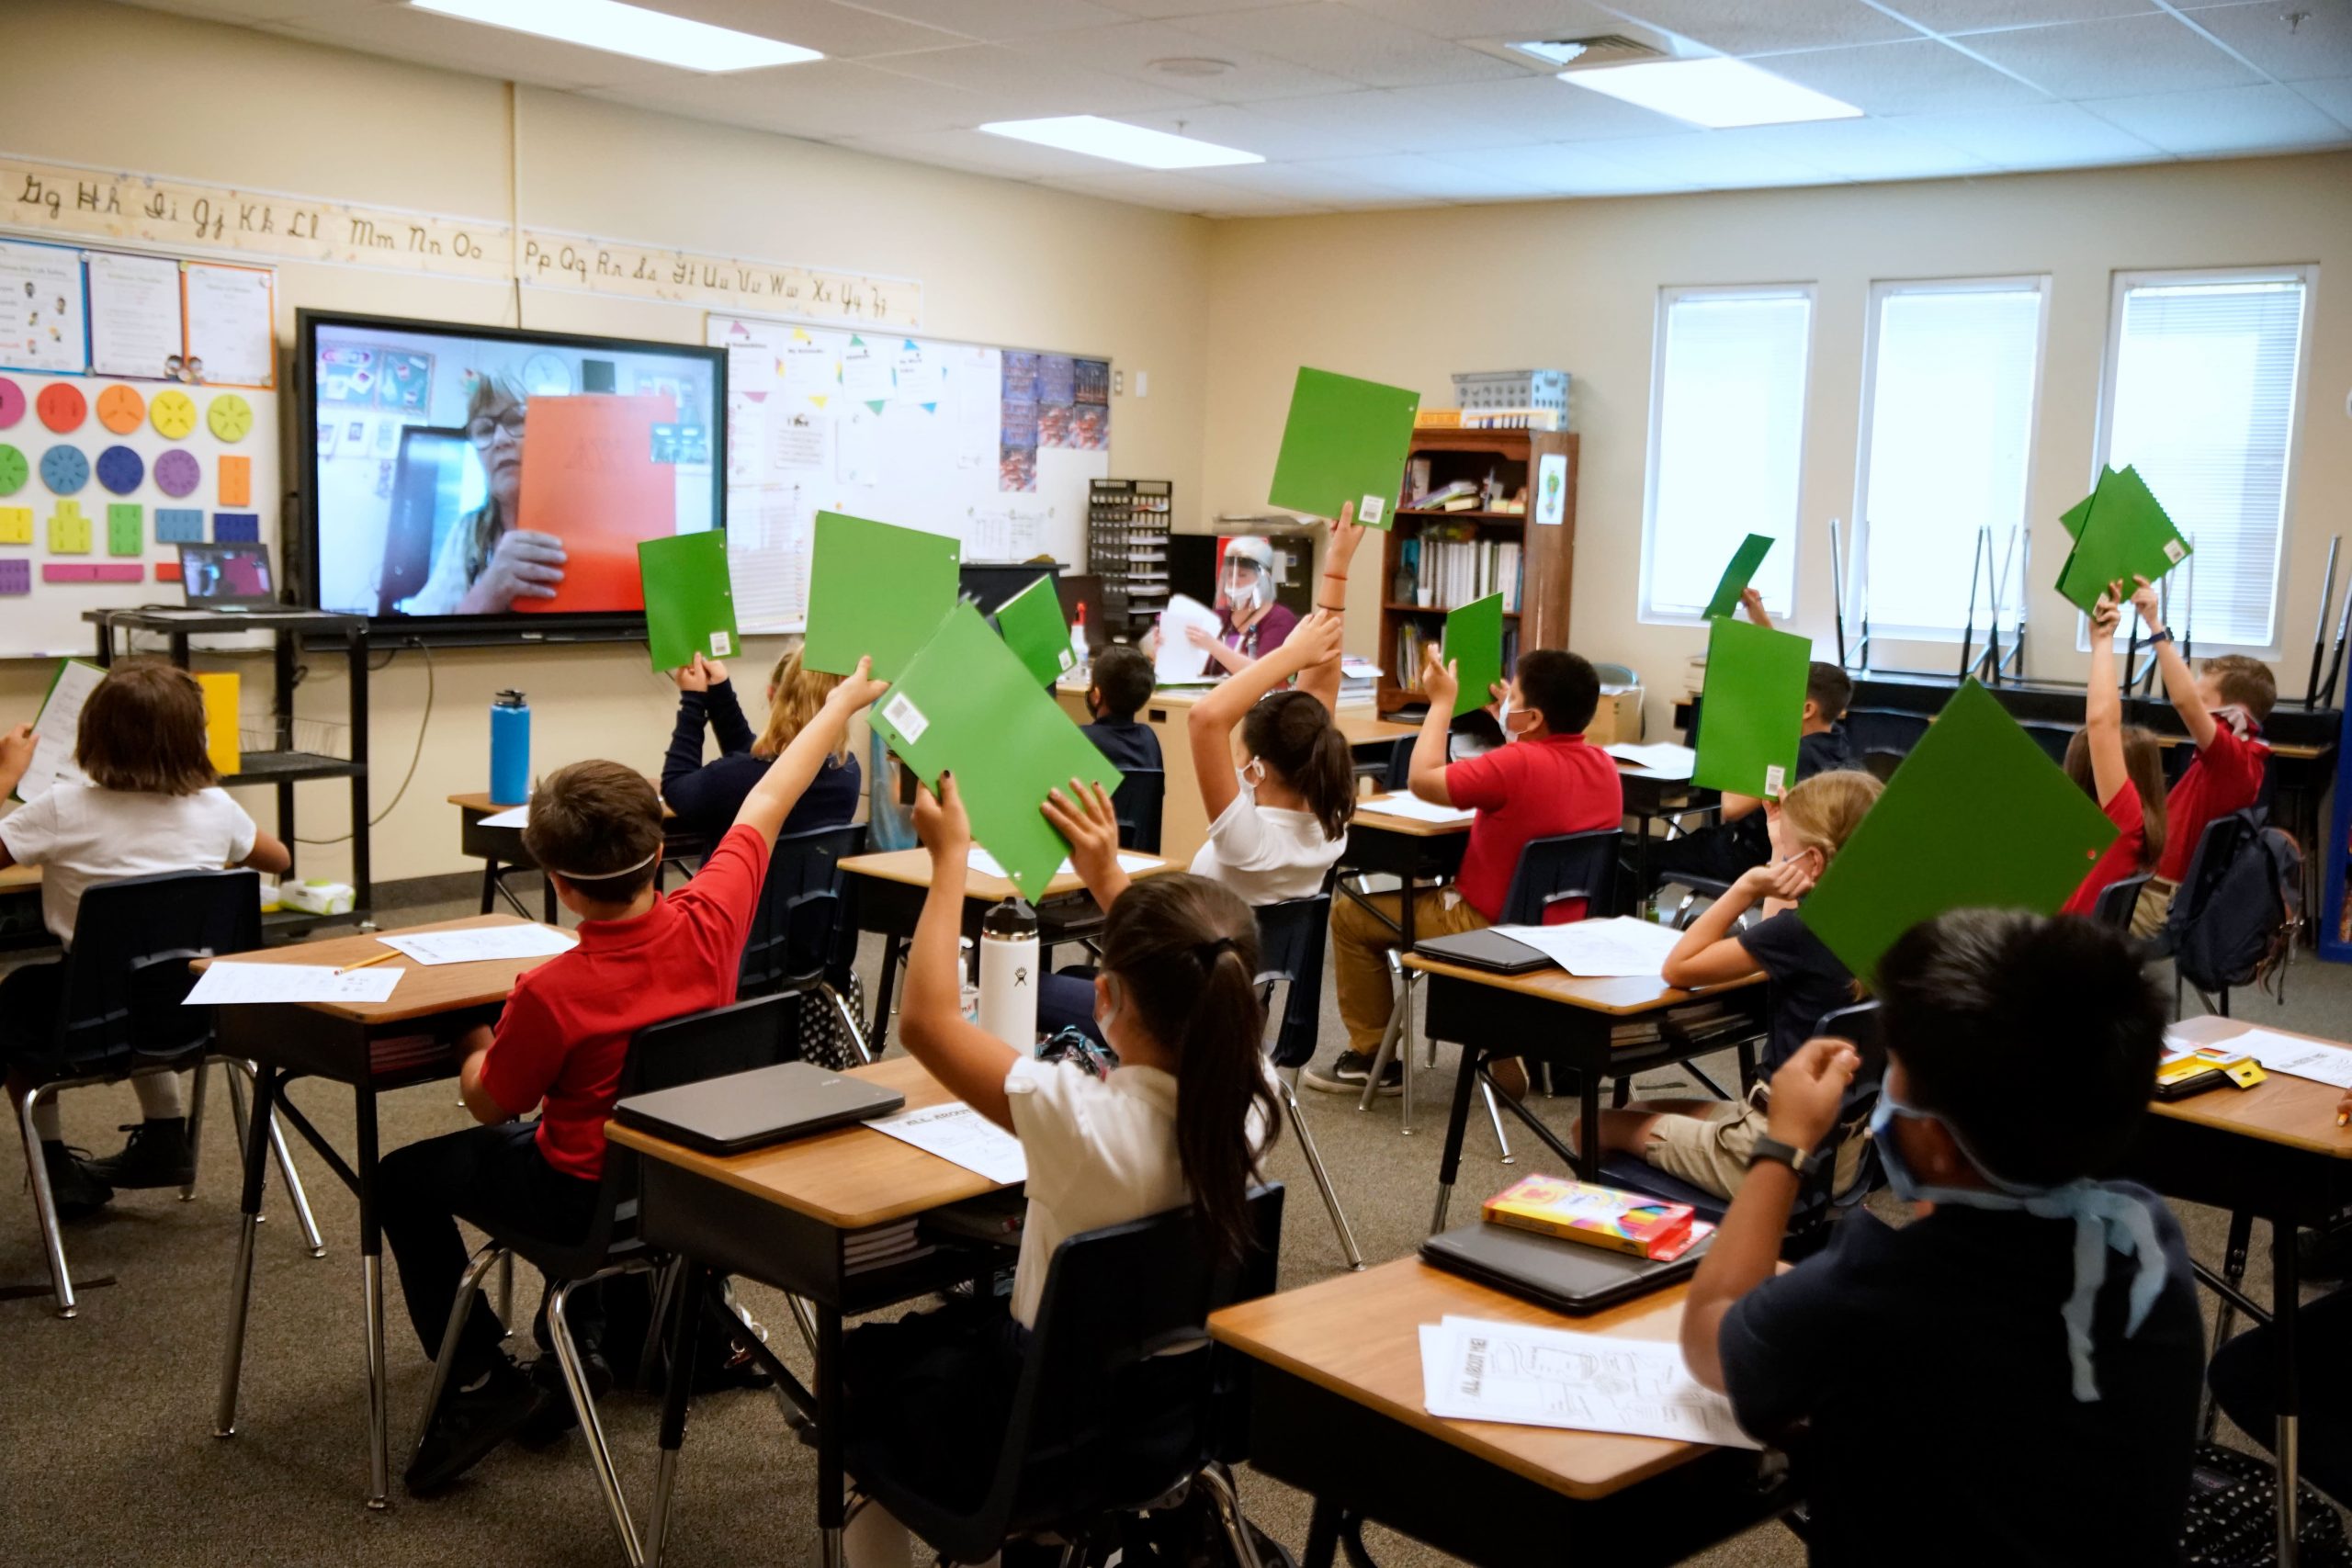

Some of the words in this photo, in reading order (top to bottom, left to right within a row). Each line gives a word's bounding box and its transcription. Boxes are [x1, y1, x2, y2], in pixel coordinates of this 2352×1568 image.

[17, 175, 61, 220] Gg
[77, 181, 121, 214] Hh
[144, 192, 177, 220] Ii
[193, 198, 224, 240] Jj
[240, 203, 274, 233] Kk
[288, 210, 319, 239] Ll
[350, 219, 395, 250] Mm
[409, 225, 442, 255] Nn
[453, 232, 482, 260] Oo
[526, 241, 551, 276] Pp
[560, 246, 587, 283] Qq
[596, 251, 624, 277] Rr
[704, 265, 729, 290] Uu
[738, 269, 762, 293] Vv
[770, 274, 799, 299] Ww
[812, 279, 831, 302] Xx
[841, 283, 862, 315] Yy
